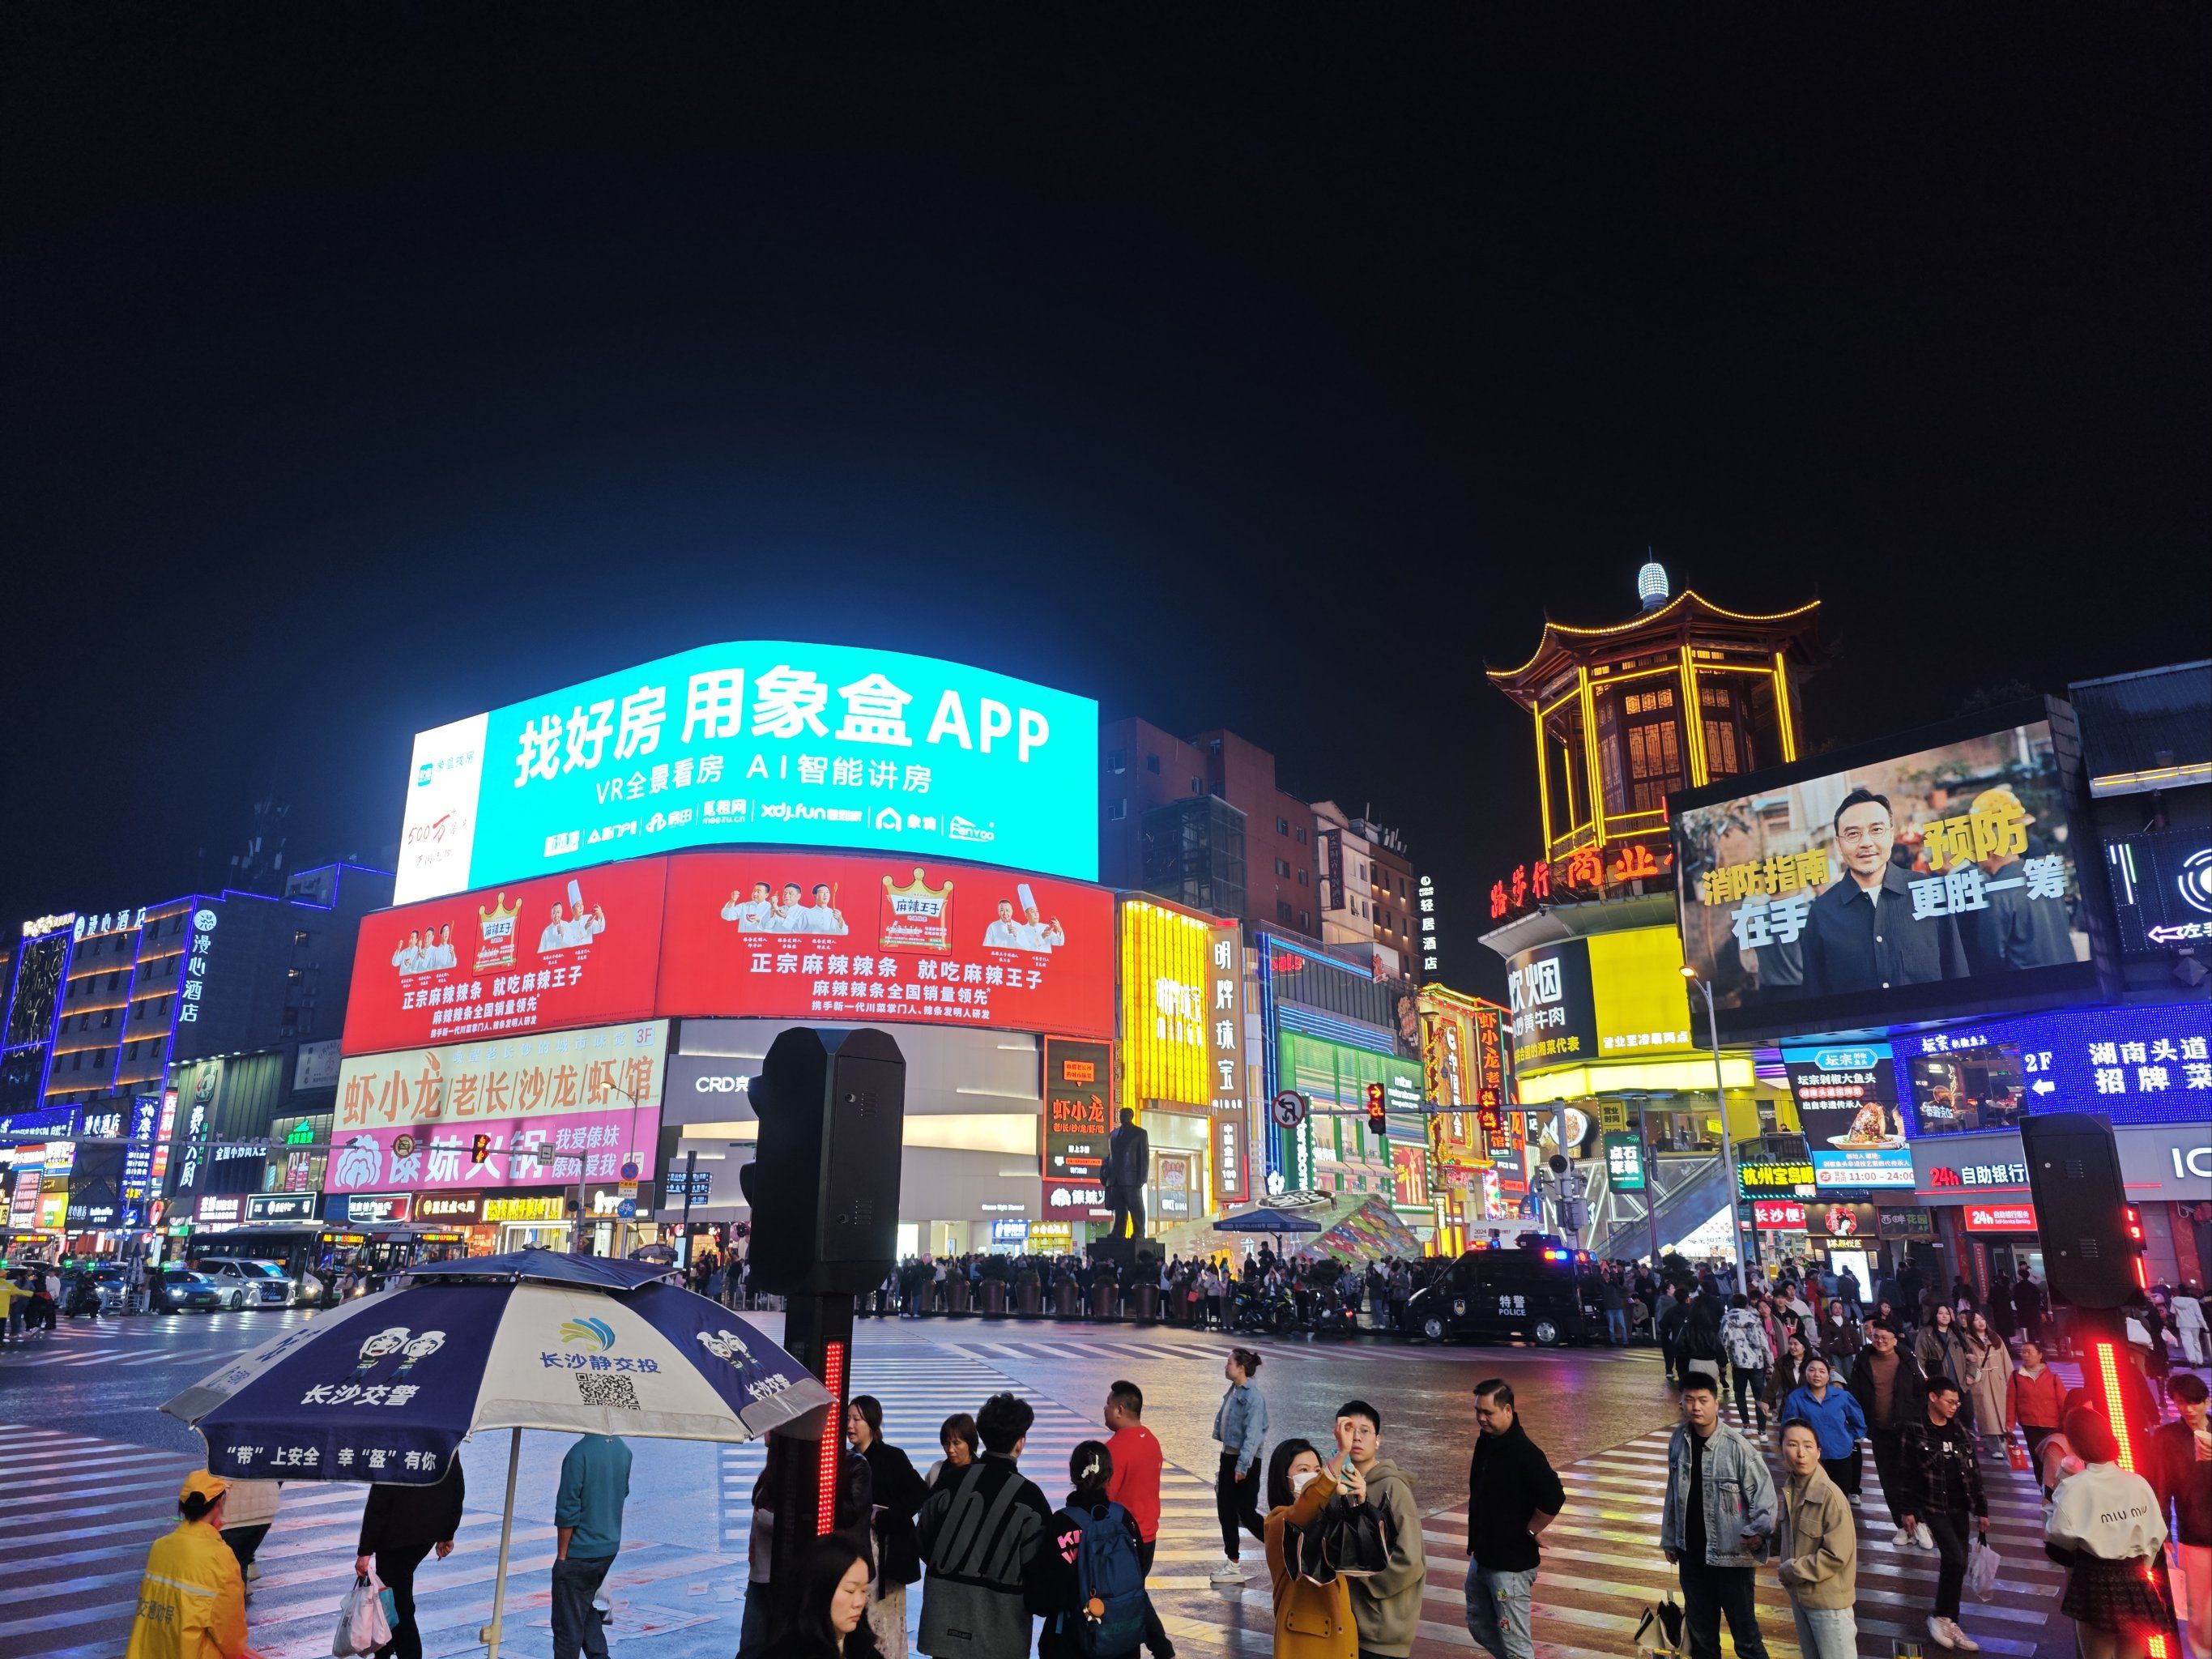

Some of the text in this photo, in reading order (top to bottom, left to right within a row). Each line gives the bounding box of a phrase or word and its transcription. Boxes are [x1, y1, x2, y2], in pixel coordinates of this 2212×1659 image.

[514, 685, 667, 788] 找好房
[596, 754, 724, 804] VR全景看房
[1924, 804, 2028, 872] 预防
[1491, 845, 1673, 918] 路步行商业
[1701, 848, 1831, 906] 消防指南
[1908, 855, 2069, 921] 更胜一筹
[897, 899, 940, 915] 麻辣王子
[87, 907, 147, 936] 漫心酒店
[1731, 895, 1808, 950] 在手
[179, 935, 211, 1022] 漫心酒店
[750, 953, 1042, 990] 正宗麻辣辣条 就吃麻辣王子
[402, 965, 583, 1011] 正宗麻辣辣条 就吃麻辣王子
[812, 980, 989, 1004] 麻辣辣条全国销量领先
[1508, 957, 1563, 1014] 炊烟
[432, 995, 538, 1025] 麻辣辣条全国销量领先
[1214, 940, 1236, 1090] 明牌珠宝
[453, 1030, 627, 1064] 唤醒老长沙的城市味觉
[636, 1026, 654, 1044] 3F
[1603, 1030, 1690, 1049] 营业至凌晨两点
[1825, 1053, 1852, 1066] 坛宗
[2025, 1051, 2053, 1073] 2F
[2089, 1036, 2207, 1065] 湖南头道
[1797, 1072, 1877, 1085] 坛宗剁椒大鱼头
[2095, 1064, 2212, 1094] 招牌菜
[1801, 1086, 1863, 1097] 湖南头道招牌菜
[1053, 1096, 1104, 1122] 虾小龙
[1802, 1100, 1863, 1110] 出自非遗传承人
[83, 1113, 121, 1135] 漫心酒店
[556, 1124, 620, 1149] 我爱傣妹
[552, 1153, 616, 1178] 傣妹爱我
[1849, 1172, 1877, 1181] 11:00
[1886, 1172, 1915, 1181] 24:00
[1929, 1164, 2029, 1187] 24h 自助银行
[1972, 1210, 1993, 1225] 24h
[1498, 1308, 1527, 1316] POLICE
[1499, 1294, 1525, 1308] 特警
[539, 1350, 662, 1375] 长沙静交投
[300, 1384, 420, 1406] 长沙交警
